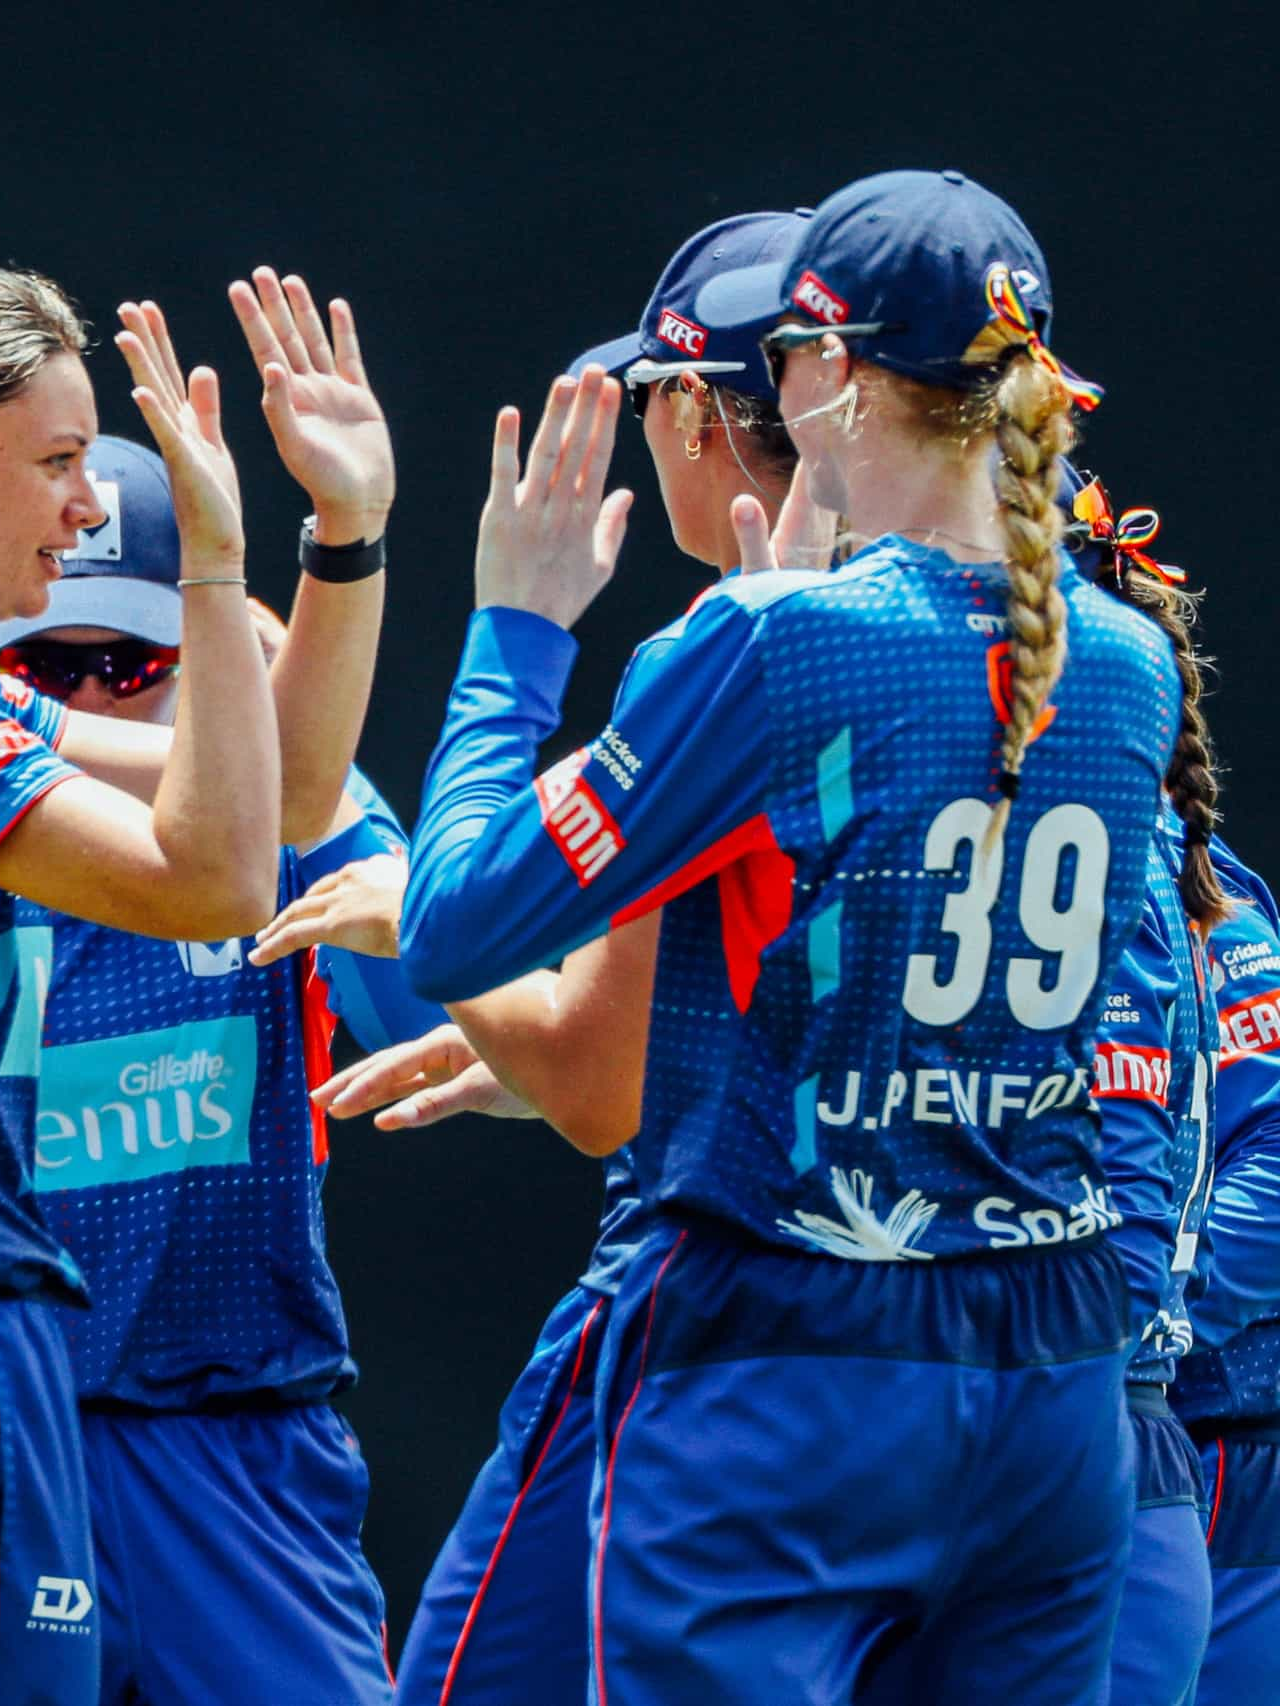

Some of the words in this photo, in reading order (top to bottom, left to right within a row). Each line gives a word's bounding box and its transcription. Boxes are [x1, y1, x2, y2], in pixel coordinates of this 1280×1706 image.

[797, 281, 844, 324] KFC
[657, 316, 705, 353] KFC
[903, 797, 1110, 1031] 39
[119, 1050, 224, 1096] Gillette
